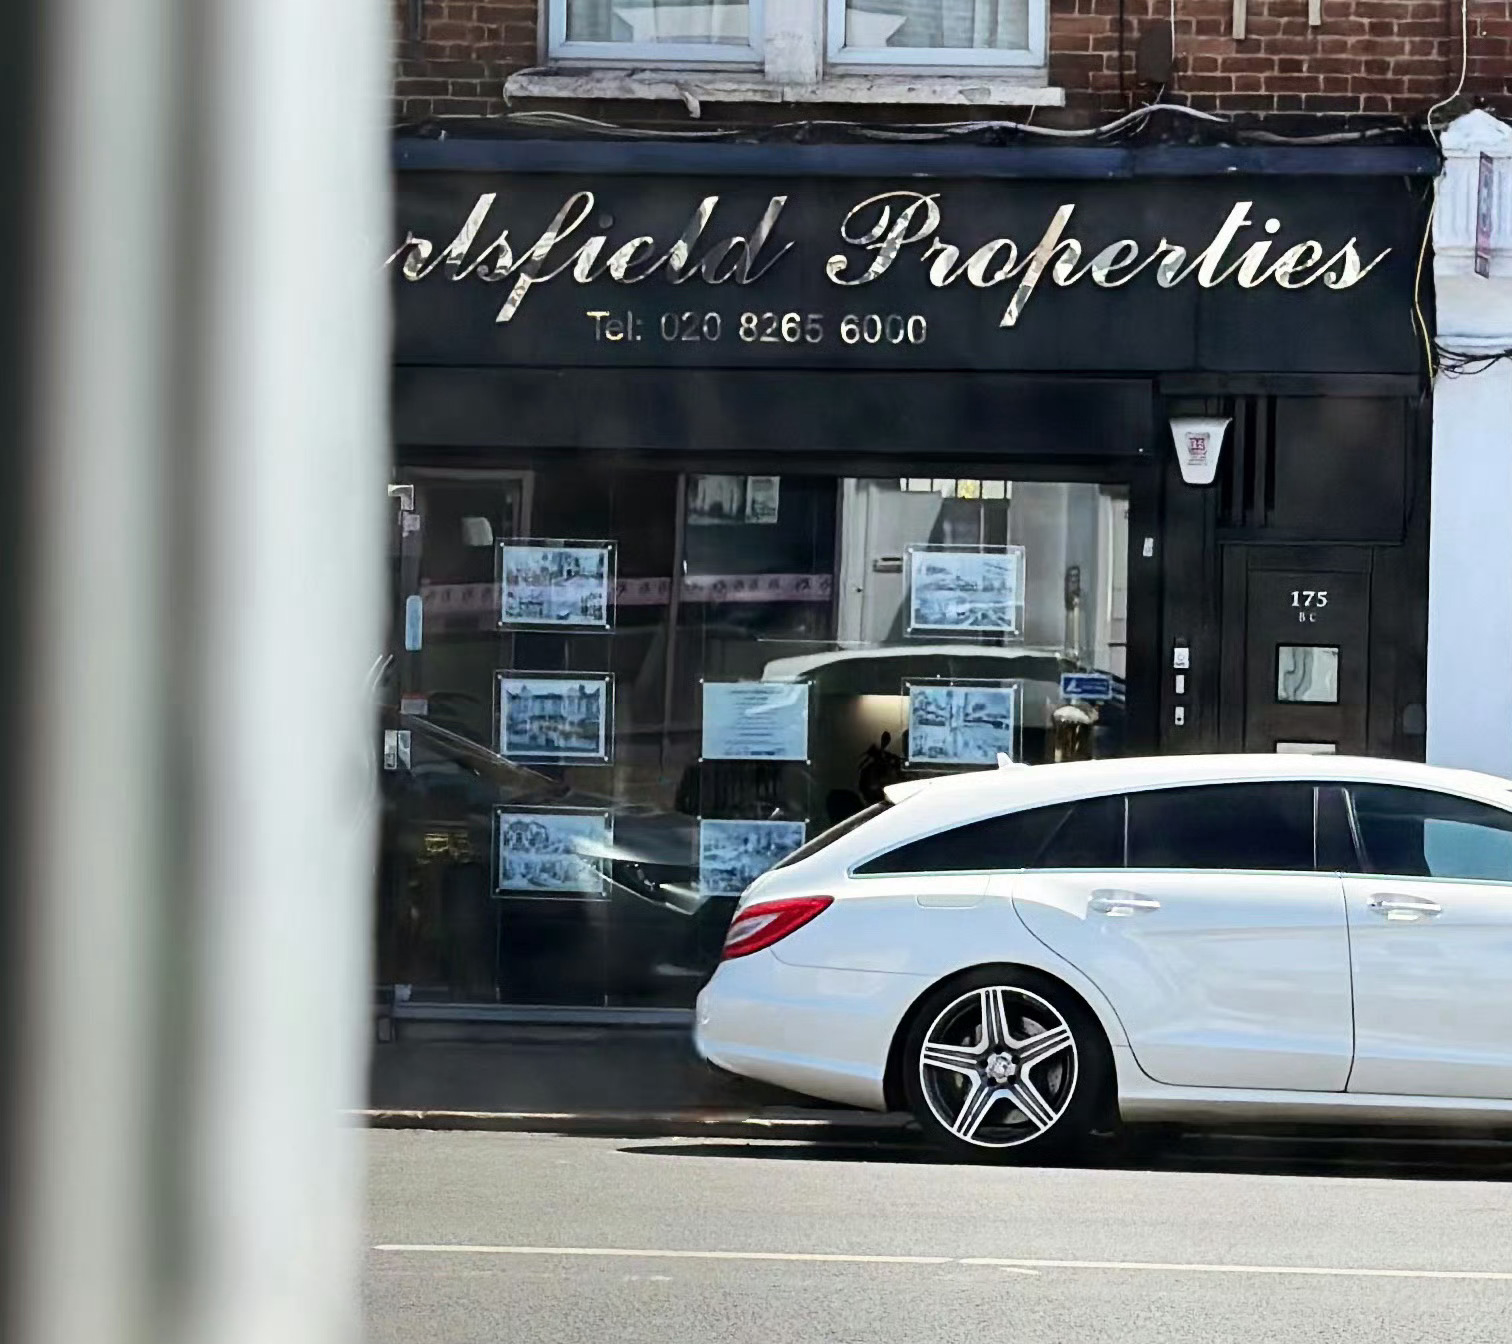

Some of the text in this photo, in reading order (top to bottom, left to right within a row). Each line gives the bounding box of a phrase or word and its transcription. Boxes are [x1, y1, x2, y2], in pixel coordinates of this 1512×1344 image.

[826, 191, 1391, 328] Properties
[587, 310, 928, 344] Tel: 020 8265 6000
[1290, 590, 1328, 607] 175
